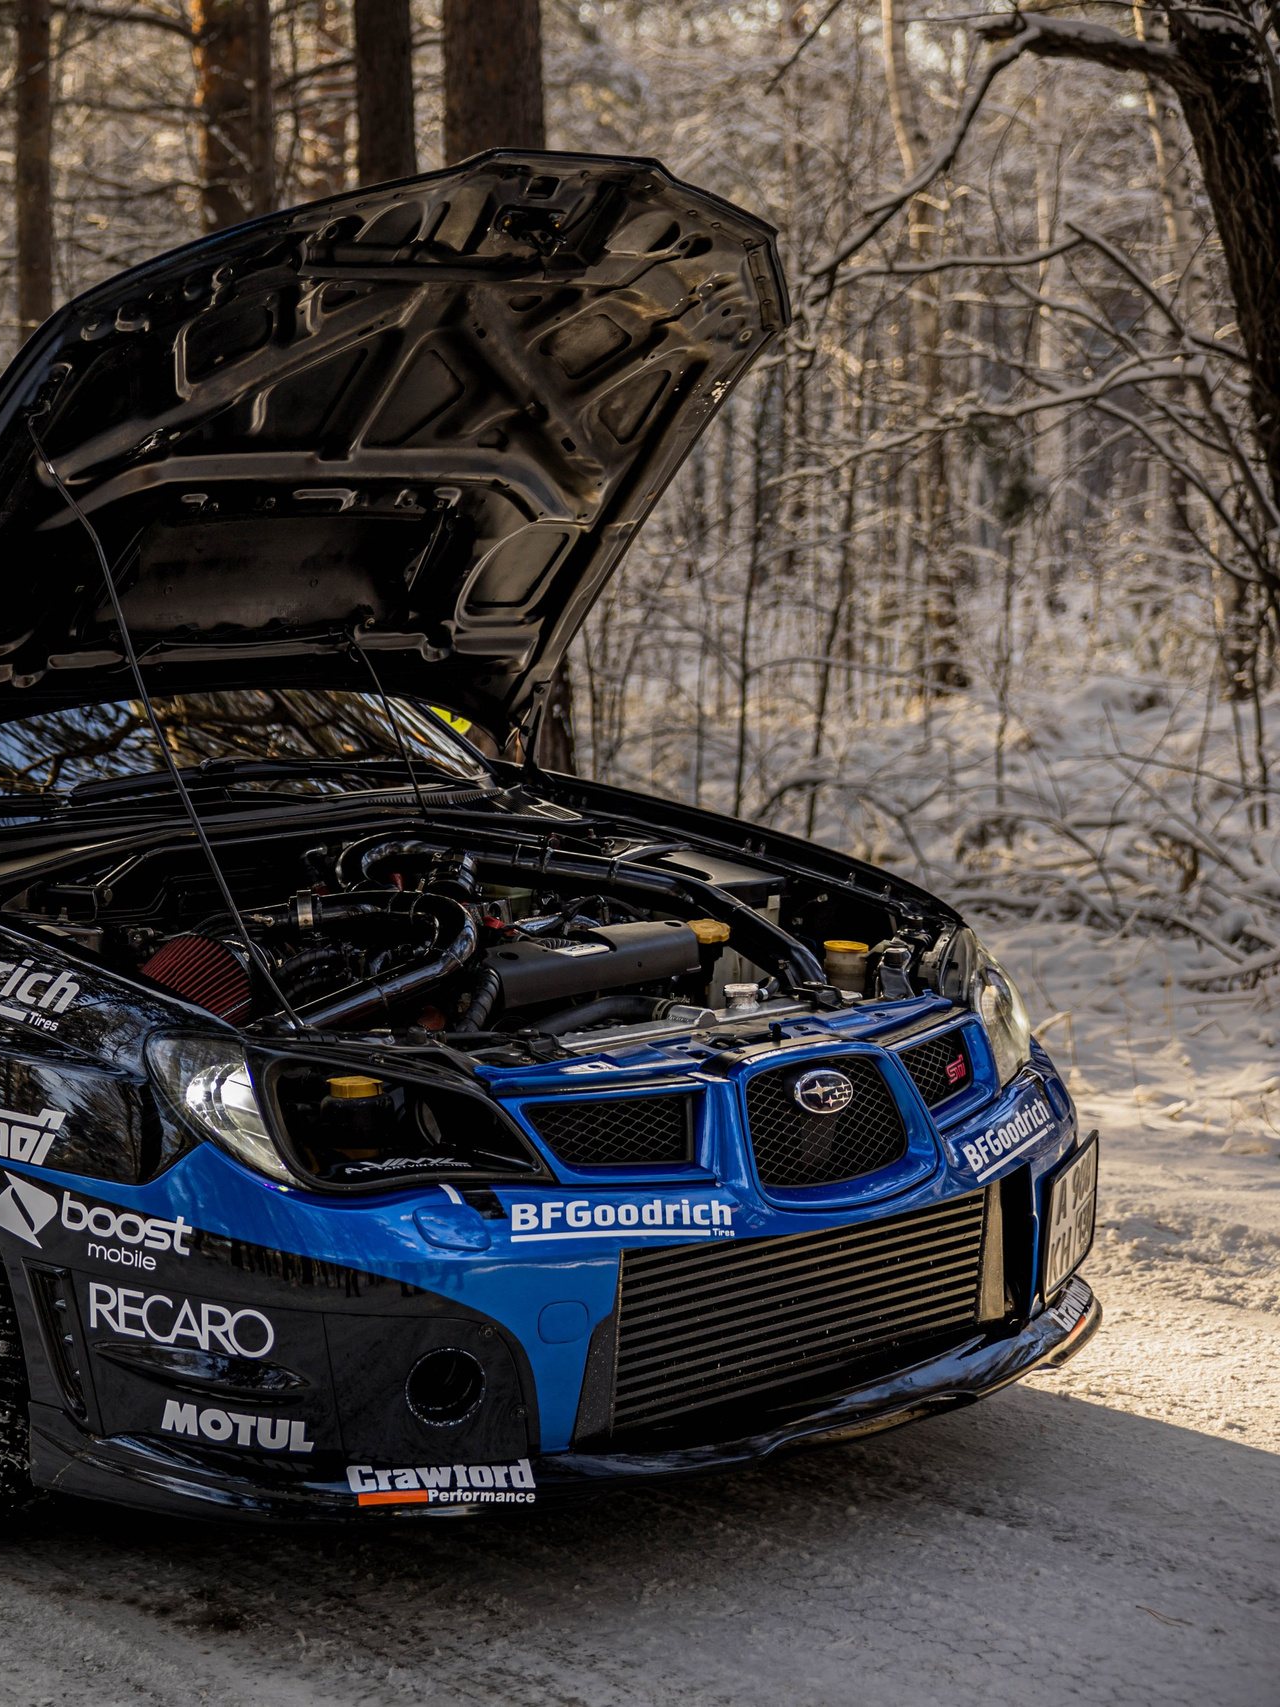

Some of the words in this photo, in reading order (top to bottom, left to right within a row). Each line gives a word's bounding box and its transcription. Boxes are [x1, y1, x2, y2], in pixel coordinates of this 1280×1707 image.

[28, 1012, 58, 1031] Tires
[962, 1098, 1050, 1172] BFGoodrich
[61, 1191, 193, 1255] boost
[511, 1199, 732, 1231] BFGoodrich
[712, 1228, 735, 1237] Tires
[87, 1242, 157, 1270] mobile
[89, 1282, 274, 1358] RECARO
[161, 1399, 314, 1452] MOTUL
[346, 1459, 536, 1493] Crawford
[428, 1490, 536, 1503] Performance
